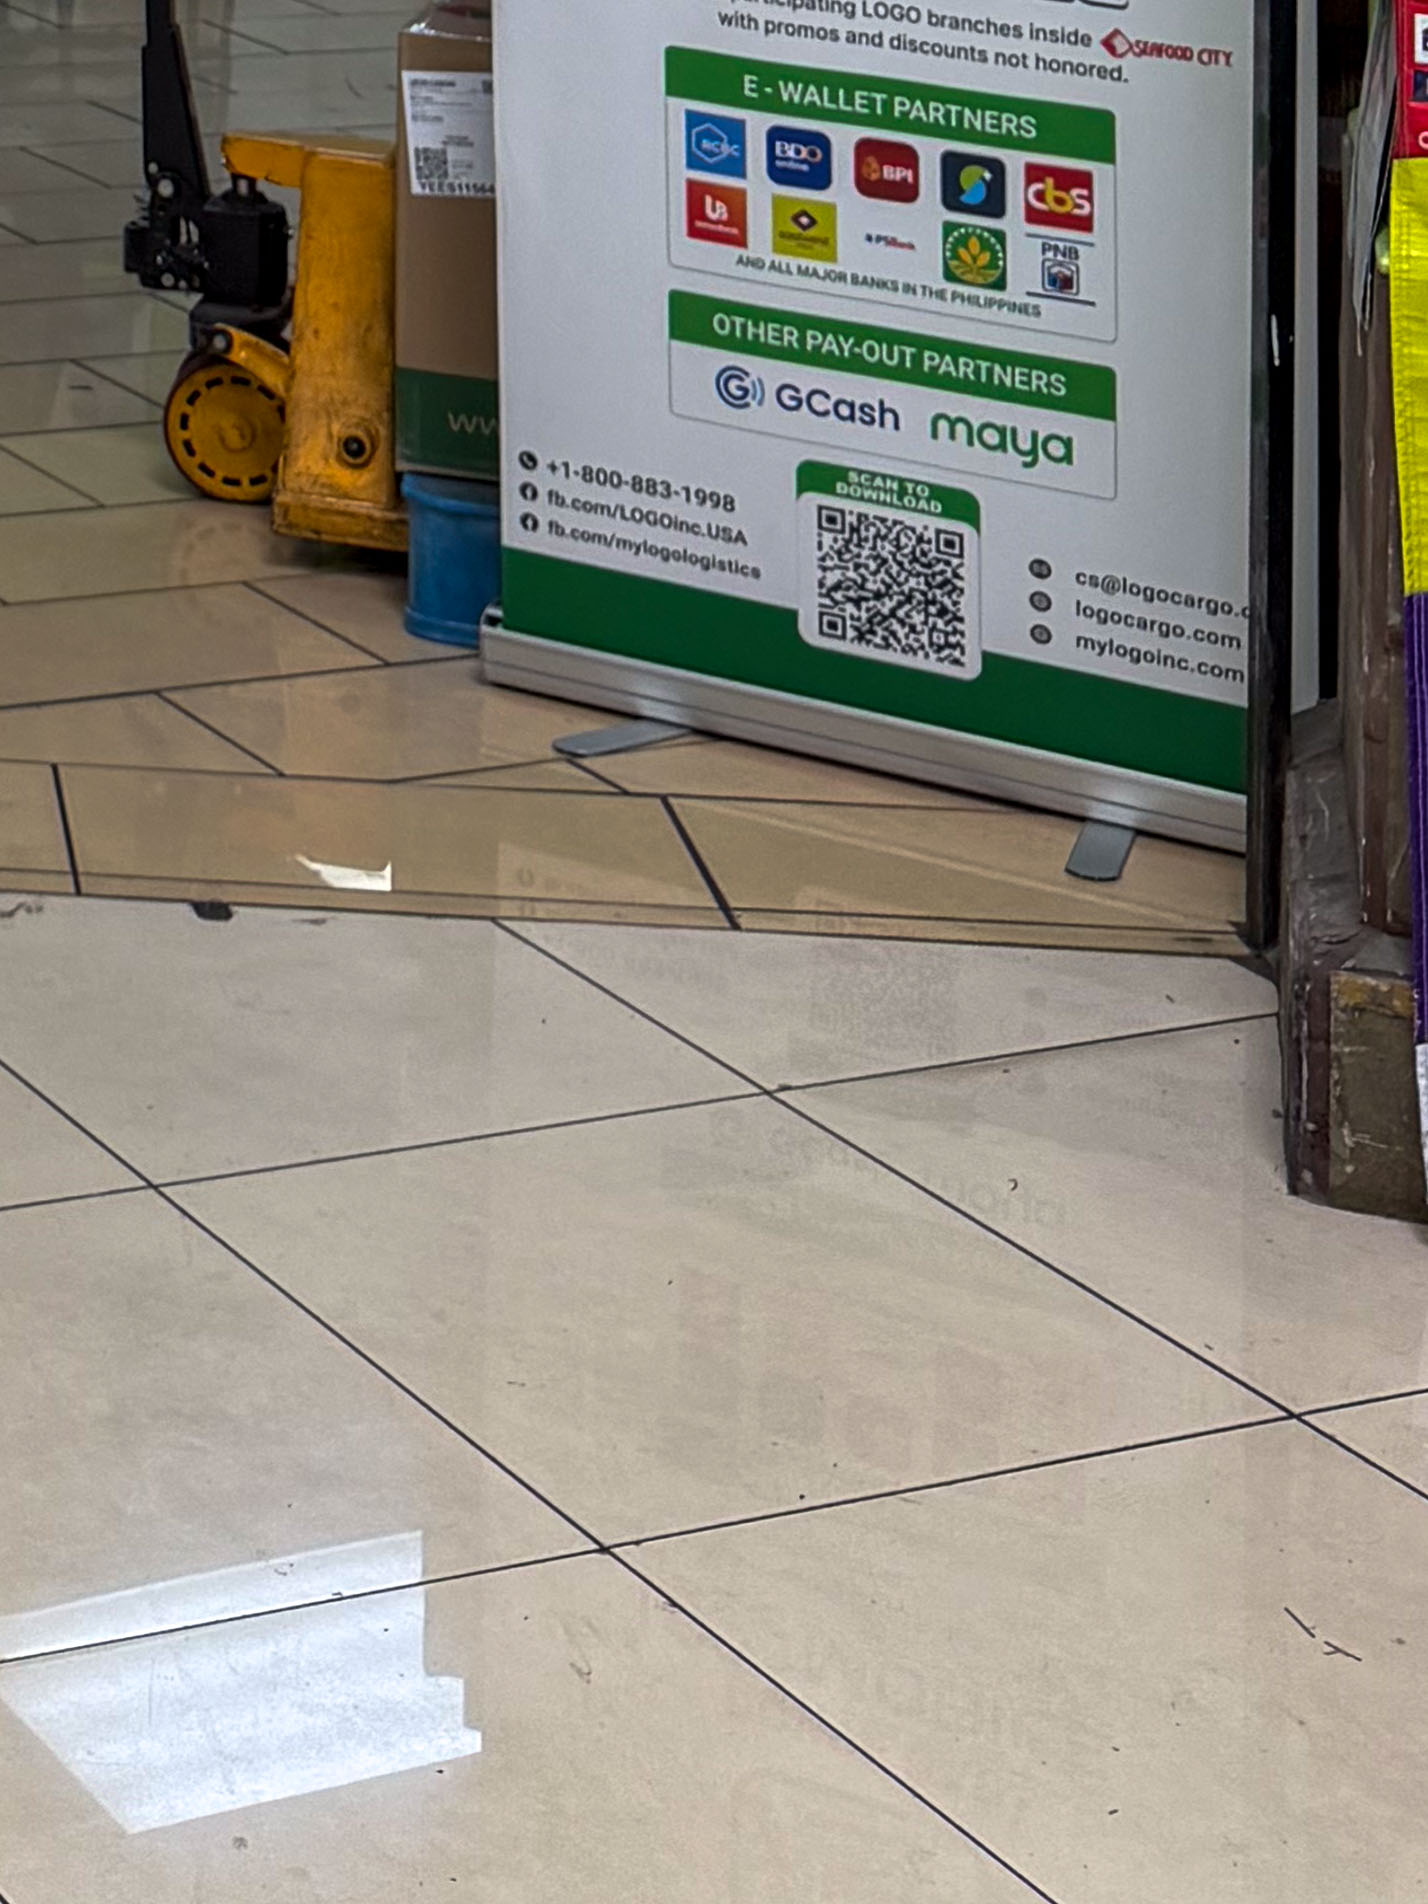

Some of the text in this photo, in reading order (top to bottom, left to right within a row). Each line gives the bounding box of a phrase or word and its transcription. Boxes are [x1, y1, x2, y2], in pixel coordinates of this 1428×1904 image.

[718, 10, 1129, 84] with promos and discounts not honored.
[862, 0, 922, 25] LOGO
[927, 9, 1023, 41] branches
[1028, 22, 1092, 48] inside
[1197, 48, 1233, 68] CITY
[779, 80, 1038, 139] WALLET PARTNERS
[774, 141, 823, 163] BDO
[882, 165, 914, 184] BPI
[1041, 242, 1080, 261] PNB
[736, 254, 1042, 318] AND ALL MAJOR BANKS IN THE PHILIPPINES
[711, 312, 1067, 397] OTHER PAY-OUT PARTNERS
[774, 383, 1075, 471] GCash maya
[546, 460, 737, 513] +1-800-883-1998
[835, 481, 943, 515] DOWNLOAD
[846, 471, 931, 497] SCAN TO
[546, 490, 748, 546] fb.com/LOGOinc.USA
[546, 519, 762, 580] fb.com/mylogologistics
[1075, 599, 1242, 650] logocargo.com
[1076, 635, 1245, 684] mylogoinc.com
